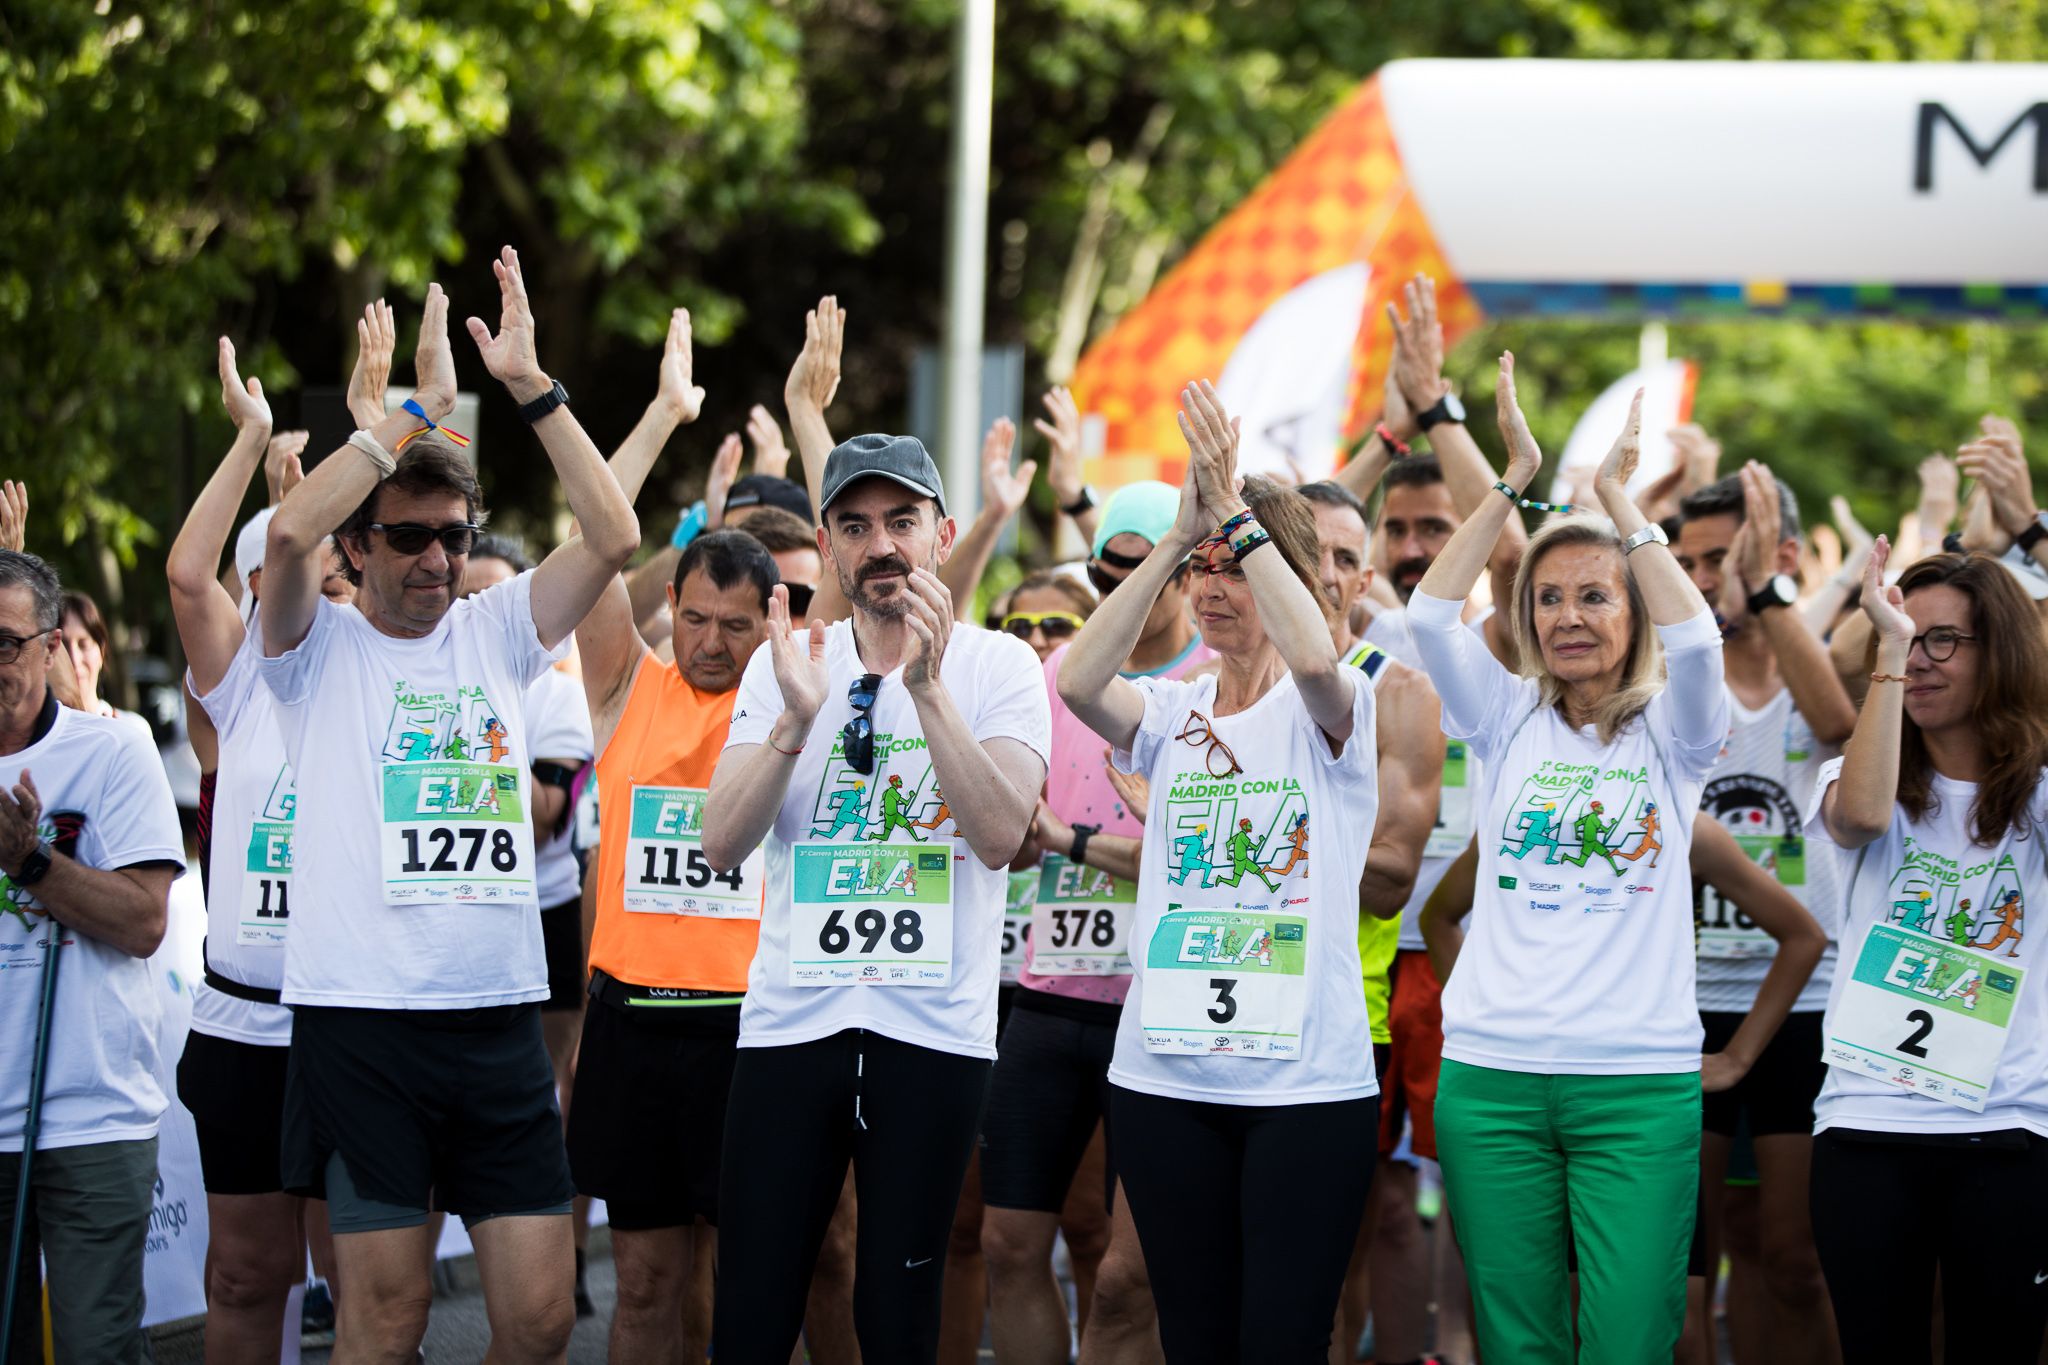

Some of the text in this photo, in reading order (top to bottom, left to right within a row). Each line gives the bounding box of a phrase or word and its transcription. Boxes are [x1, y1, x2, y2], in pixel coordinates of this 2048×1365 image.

[890, 737, 928, 753] CON
[421, 766, 461, 776] MADRID
[461, 767, 480, 776] CON
[480, 768, 491, 777] LA
[1532, 773, 1594, 790] MADRID
[415, 776, 500, 816] ELA
[664, 793, 697, 802] MADRID
[1169, 778, 1301, 799] MADRID CON LA
[1166, 792, 1309, 869] ELA
[401, 827, 518, 873] 1278
[833, 849, 871, 858] MADRID
[873, 849, 896, 857] CON
[896, 850, 909, 858] LA
[1904, 850, 1961, 883] MADRID
[824, 858, 916, 897] ELA
[1055, 865, 1115, 899] ELA
[1585, 886, 1612, 896] Biogen
[1188, 915, 1227, 925] MADRID
[1228, 917, 1251, 926] CON
[1252, 918, 1266, 927] LA
[1537, 903, 1561, 911] MADRID
[819, 908, 924, 955] 698
[1051, 908, 1116, 948] 378
[1177, 925, 1271, 967] ELA
[1903, 938, 1943, 956] MADRID
[1943, 949, 1967, 964] CON
[1966, 957, 1982, 968] LA
[1883, 947, 1980, 1011] ELA
[1207, 978, 1238, 1024] 3
[1896, 1009, 1935, 1060] 2
